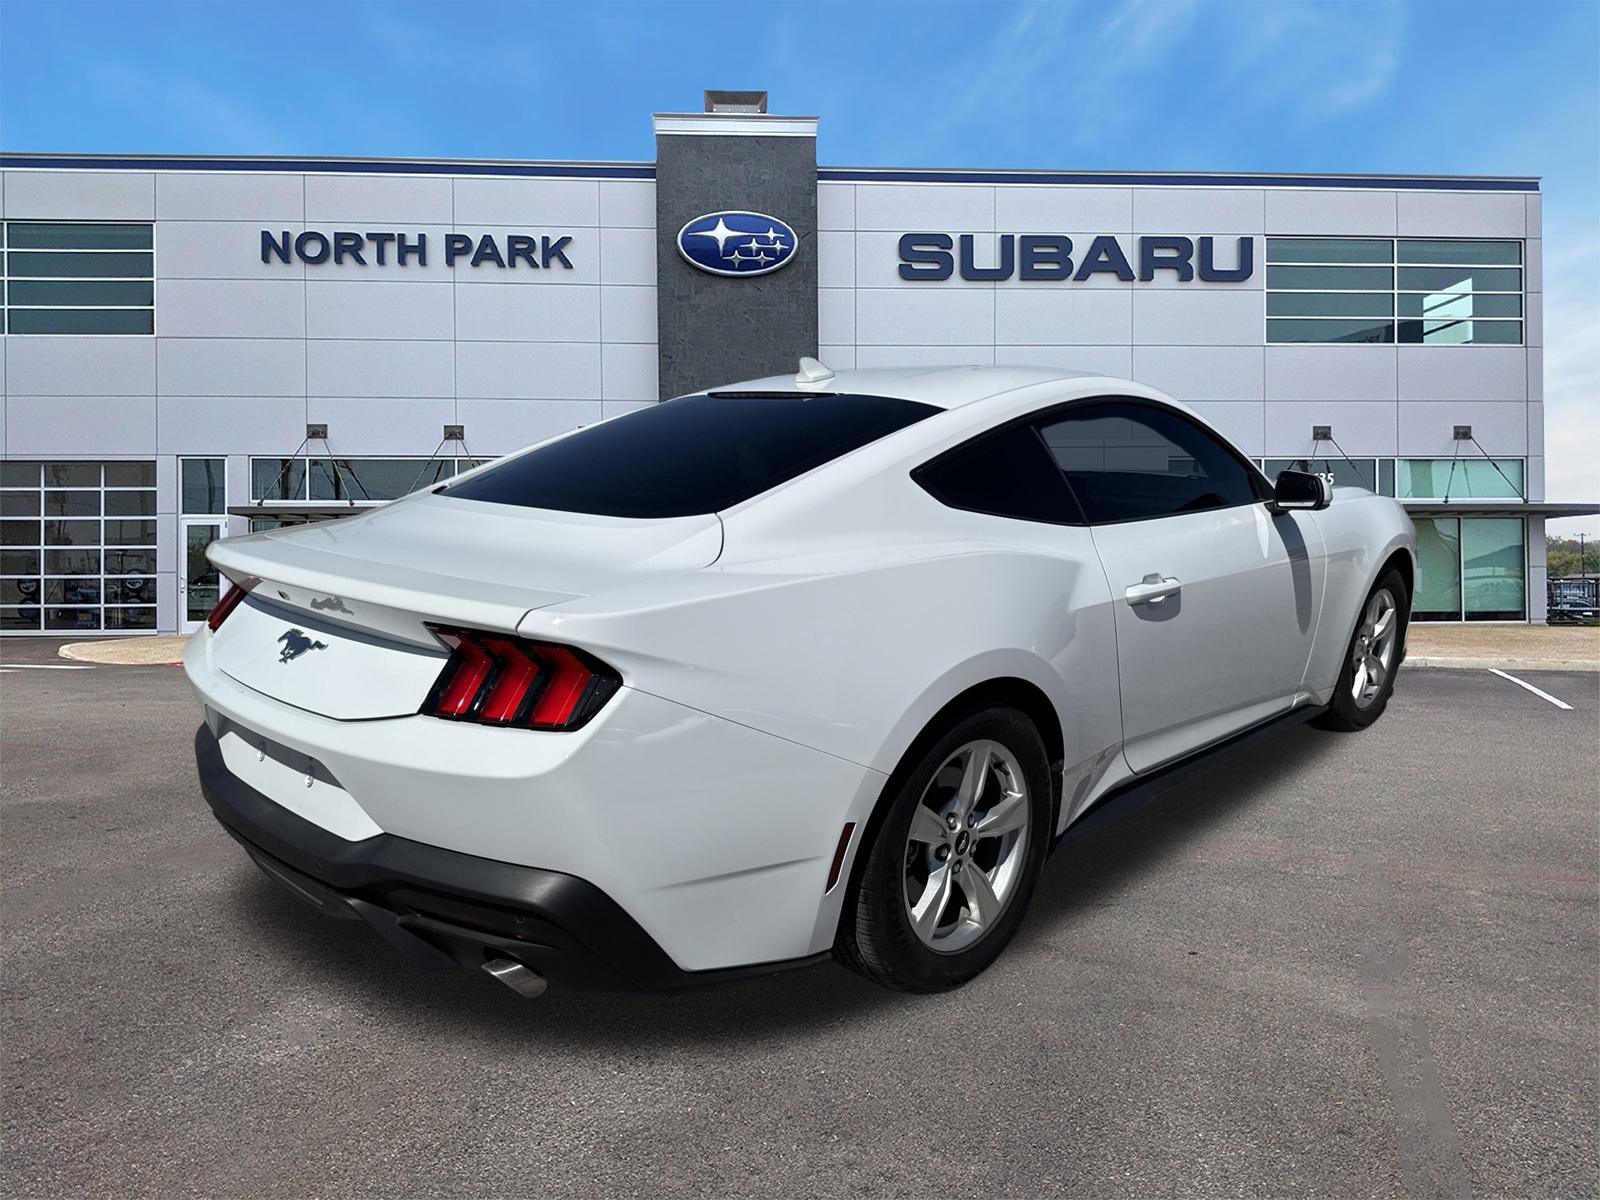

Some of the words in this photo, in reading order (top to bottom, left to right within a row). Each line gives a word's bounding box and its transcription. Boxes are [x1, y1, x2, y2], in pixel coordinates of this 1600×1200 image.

[260, 230, 428, 268] NORTH
[444, 233, 575, 270] PARK
[897, 232, 1254, 284] SUBARU
